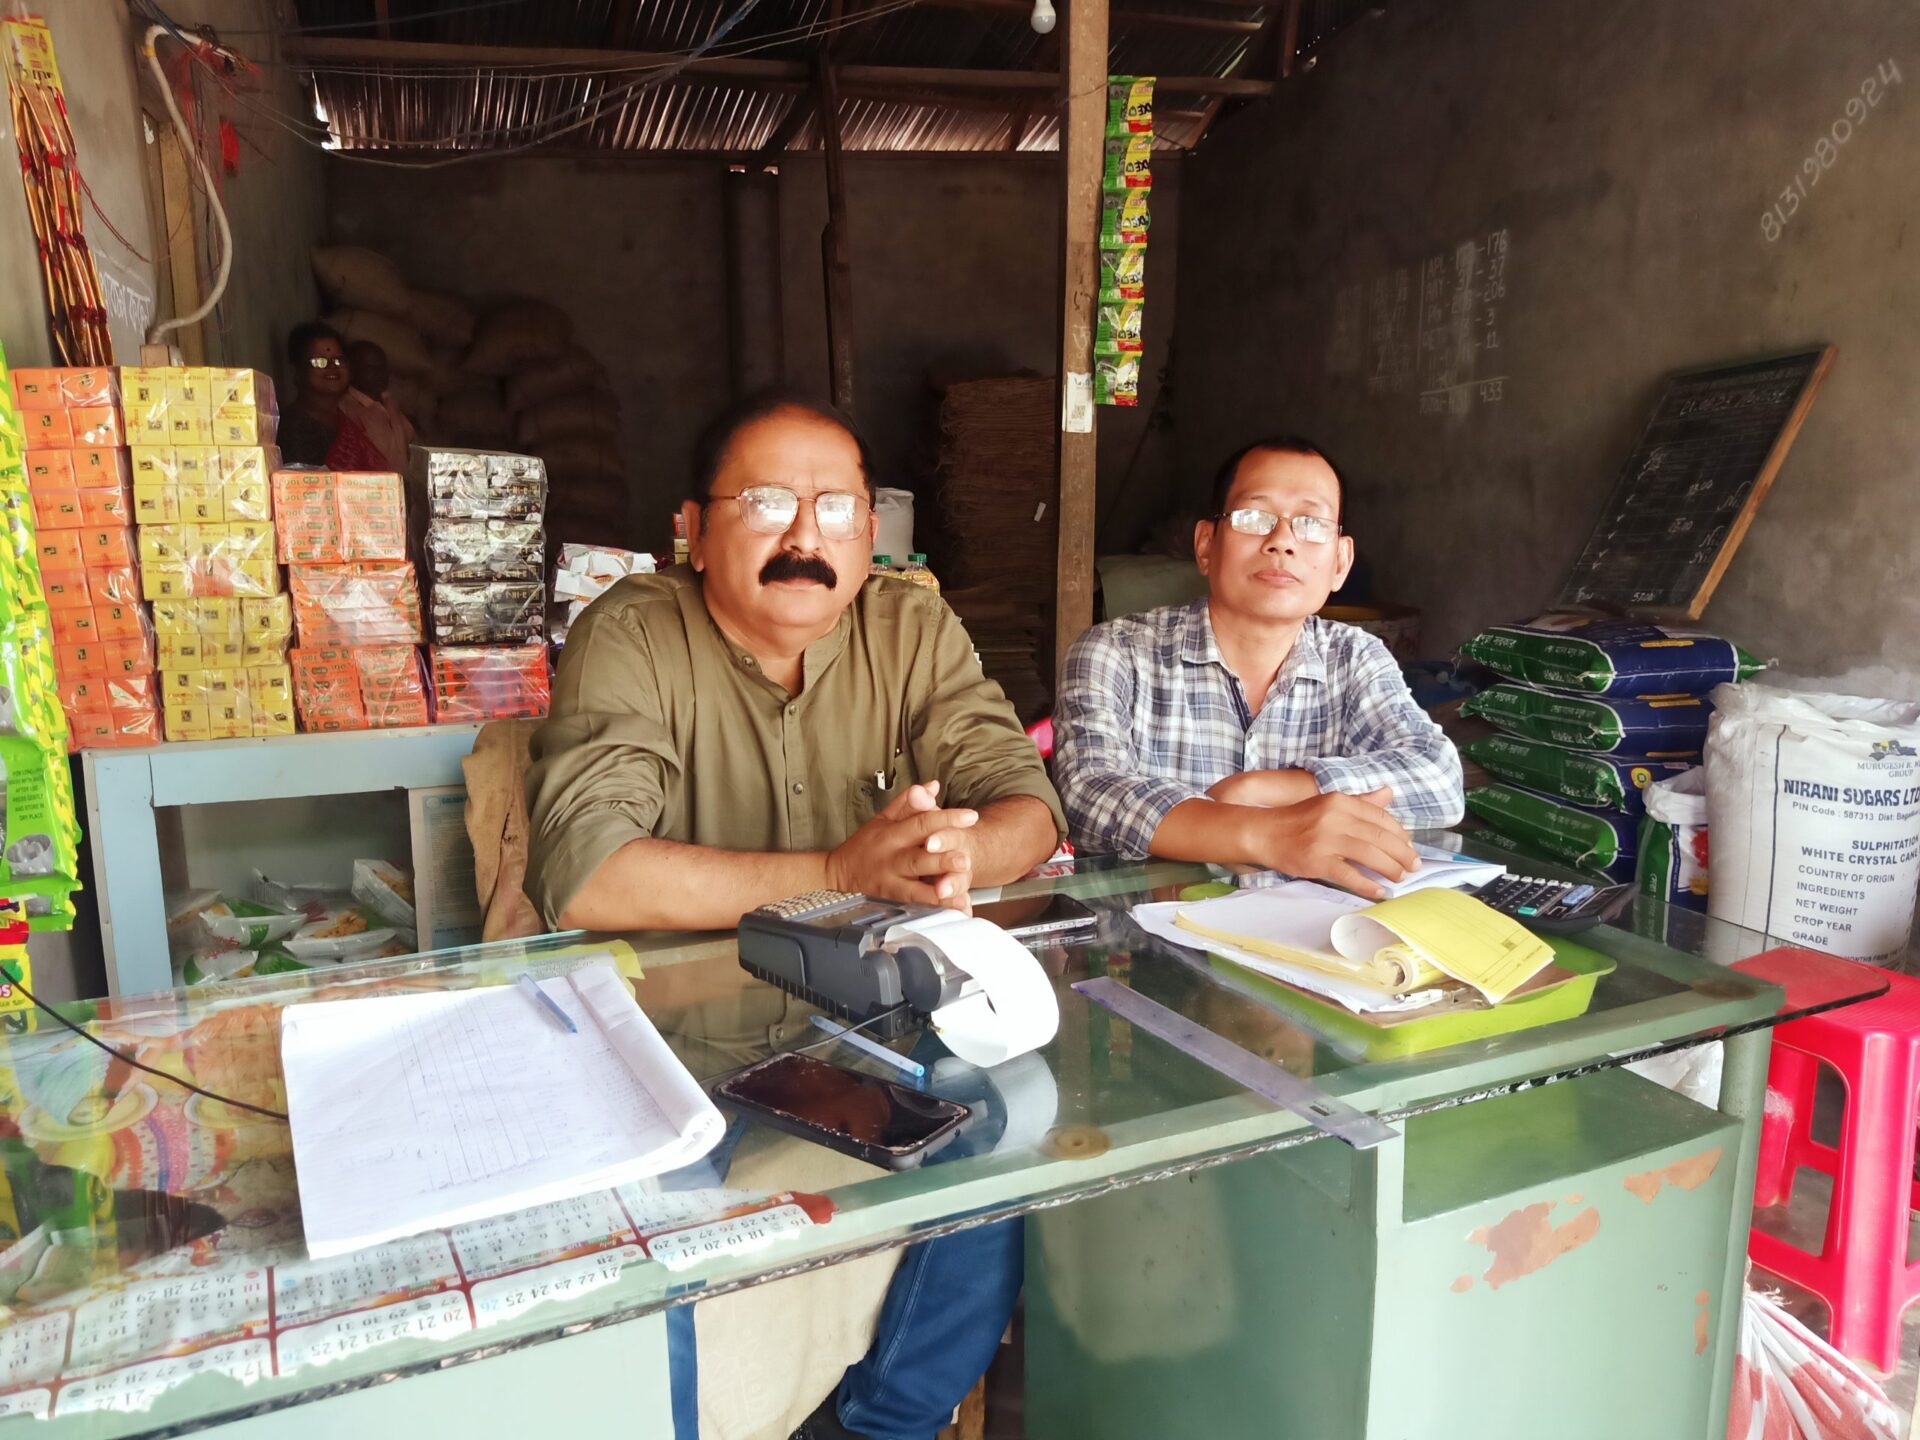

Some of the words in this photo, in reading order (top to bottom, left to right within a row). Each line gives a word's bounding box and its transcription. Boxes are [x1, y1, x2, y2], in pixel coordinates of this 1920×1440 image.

[1761, 58, 1902, 241] 8131980924
[1486, 229, 1508, 254] 176
[1488, 256, 1506, 280] 37
[1889, 769, 1914, 778] GROUP
[1784, 779, 1839, 802] NIRANI
[1843, 787, 1902, 807] SUGARS
[1792, 801, 1809, 811] PIN
[1811, 805, 1836, 816] Code
[1843, 810, 1874, 821] 587313
[1851, 834, 1919, 851] SULPHITATION
[1801, 846, 1845, 863] WHITE
[1848, 854, 1898, 866] CRYSTAL
[1900, 848, 1918, 863] CANE
[1798, 864, 1849, 881] COUNTRY
[1851, 873, 1864, 883] OF
[1866, 874, 1896, 884] ORIGIN
[1796, 881, 1866, 900] INGREDIENTS
[1795, 898, 1817, 909] NET
[1819, 903, 1859, 916] WEIGHT
[1794, 914, 1824, 927] CROP
[1826, 921, 1853, 933] YEAR
[1792, 931, 1829, 946] GRADE
[741, 1219, 758, 1228] 25
[762, 1214, 779, 1223] 24
[698, 1229, 714, 1239] 27
[719, 1224, 737, 1233] 26
[747, 1228, 765, 1240] 18
[654, 1240, 672, 1250] 29
[704, 1239, 720, 1251] 20
[727, 1234, 743, 1246] 19
[682, 1245, 697, 1258] 21
[603, 1266, 618, 1278] 21
[191, 1279, 208, 1291] 27
[578, 1273, 595, 1285] 22
[136, 1291, 156, 1302] 29
[163, 1285, 182, 1297] 28
[531, 1285, 549, 1298] 24
[441, 1296, 460, 1306] 27
[505, 1292, 525, 1306] 25
[480, 1300, 499, 1312] 26
[389, 1309, 408, 1320] 29
[443, 1309, 462, 1323] 20
[362, 1317, 381, 1326] 30
[418, 1316, 436, 1331] 21
[392, 1322, 409, 1336] 22
[365, 1329, 385, 1343] 23
[312, 1343, 332, 1356] 25
[339, 1336, 358, 1351] 24
[214, 1351, 234, 1362] 25
[125, 1371, 147, 1384] 28
[156, 1367, 176, 1377] 27
